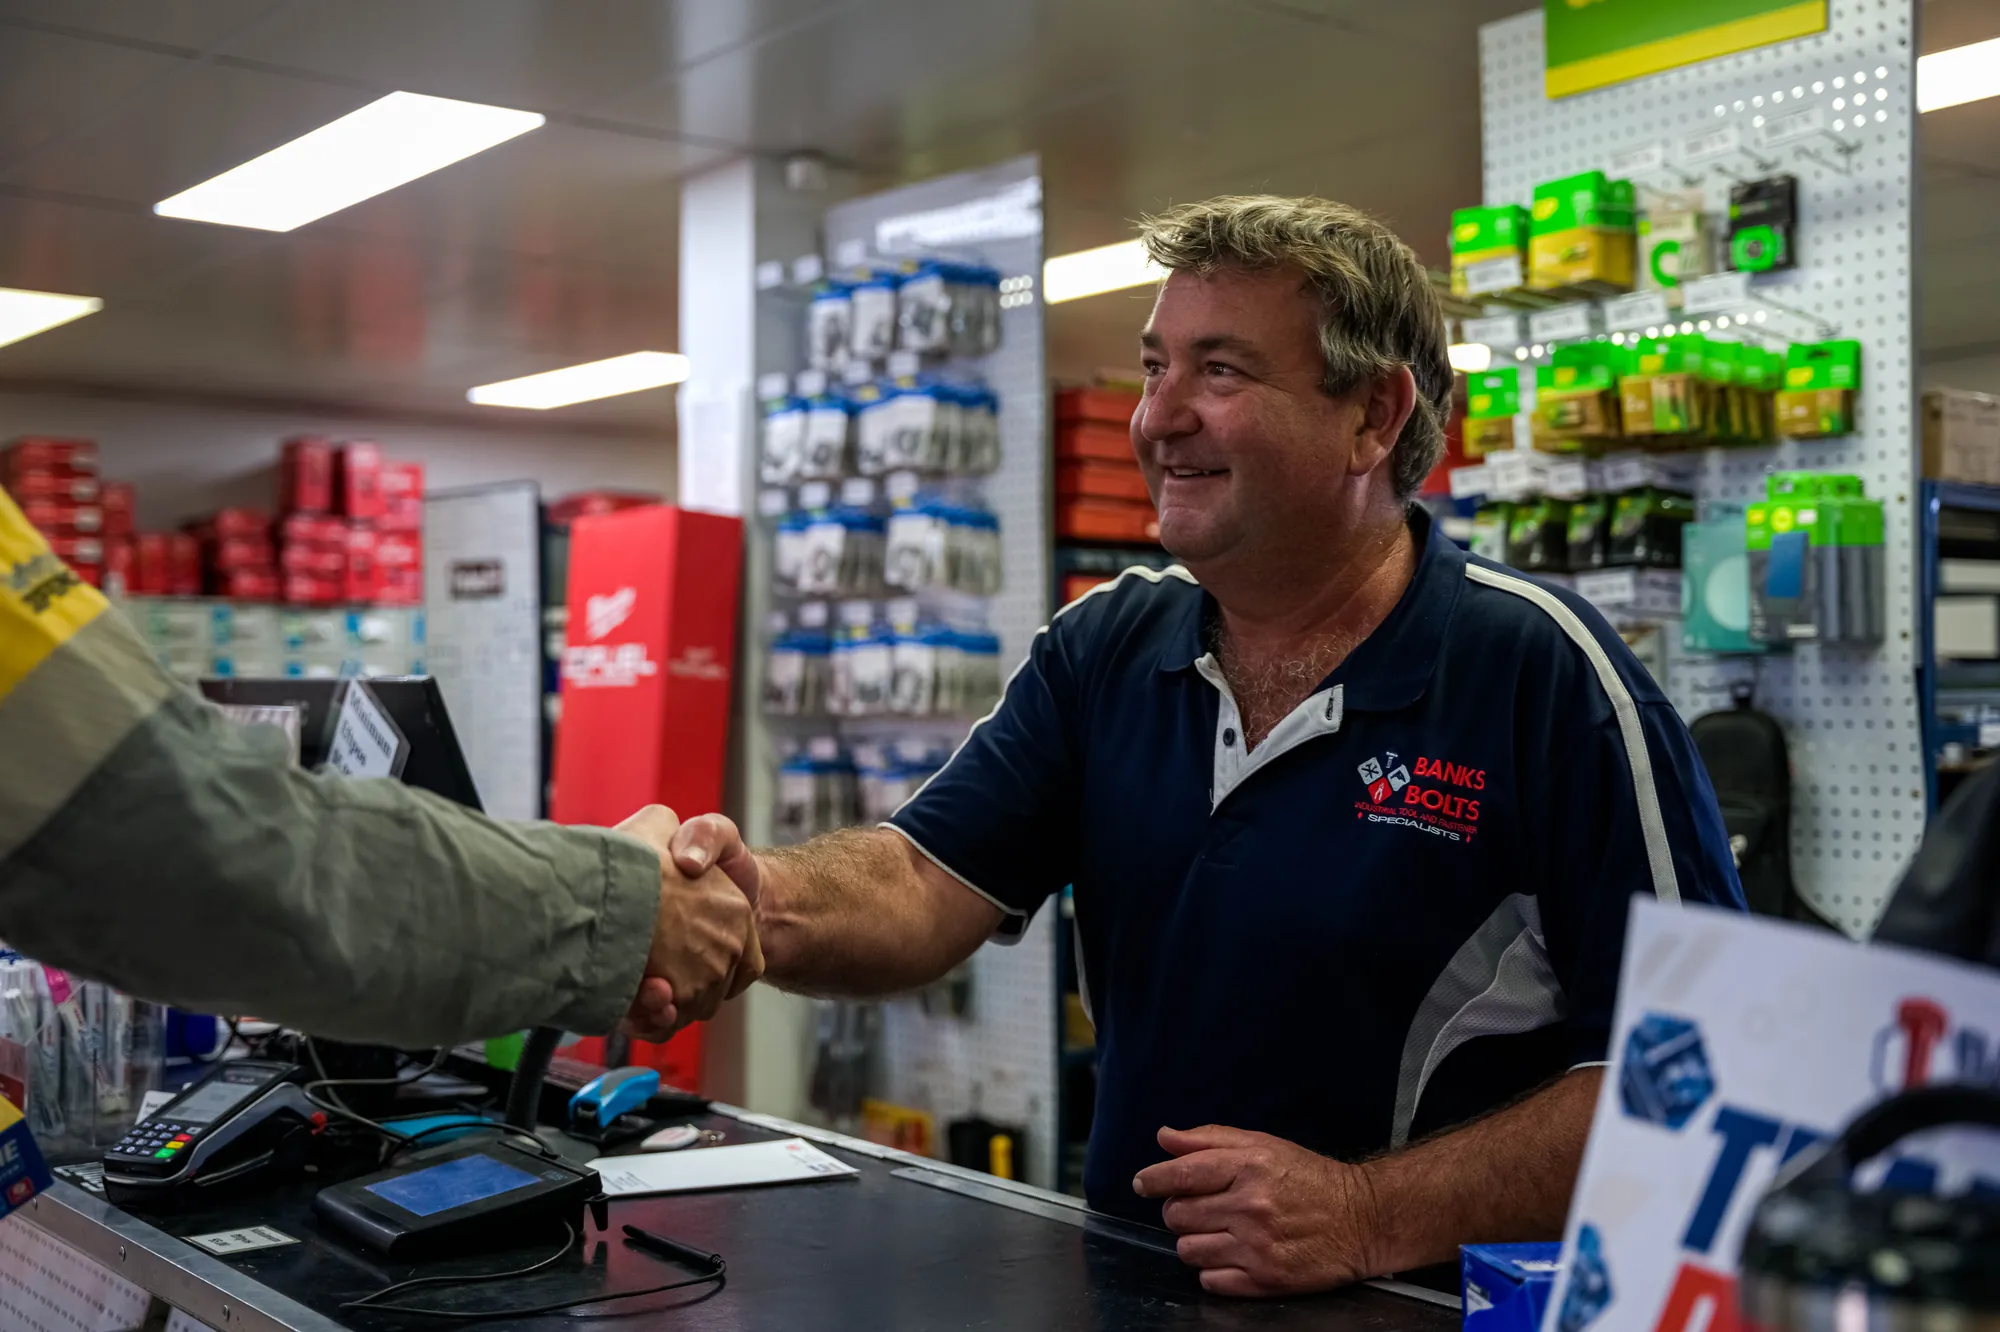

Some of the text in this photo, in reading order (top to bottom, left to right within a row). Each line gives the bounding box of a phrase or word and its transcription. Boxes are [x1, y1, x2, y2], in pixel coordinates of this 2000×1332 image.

[1413, 757, 1486, 790] BANKS
[1354, 801, 1478, 834] INDUSTRIAL TOOL AND FASTENER
[1404, 785, 1481, 820] BOLTS
[1367, 813, 1461, 841] SPECIALISTS
